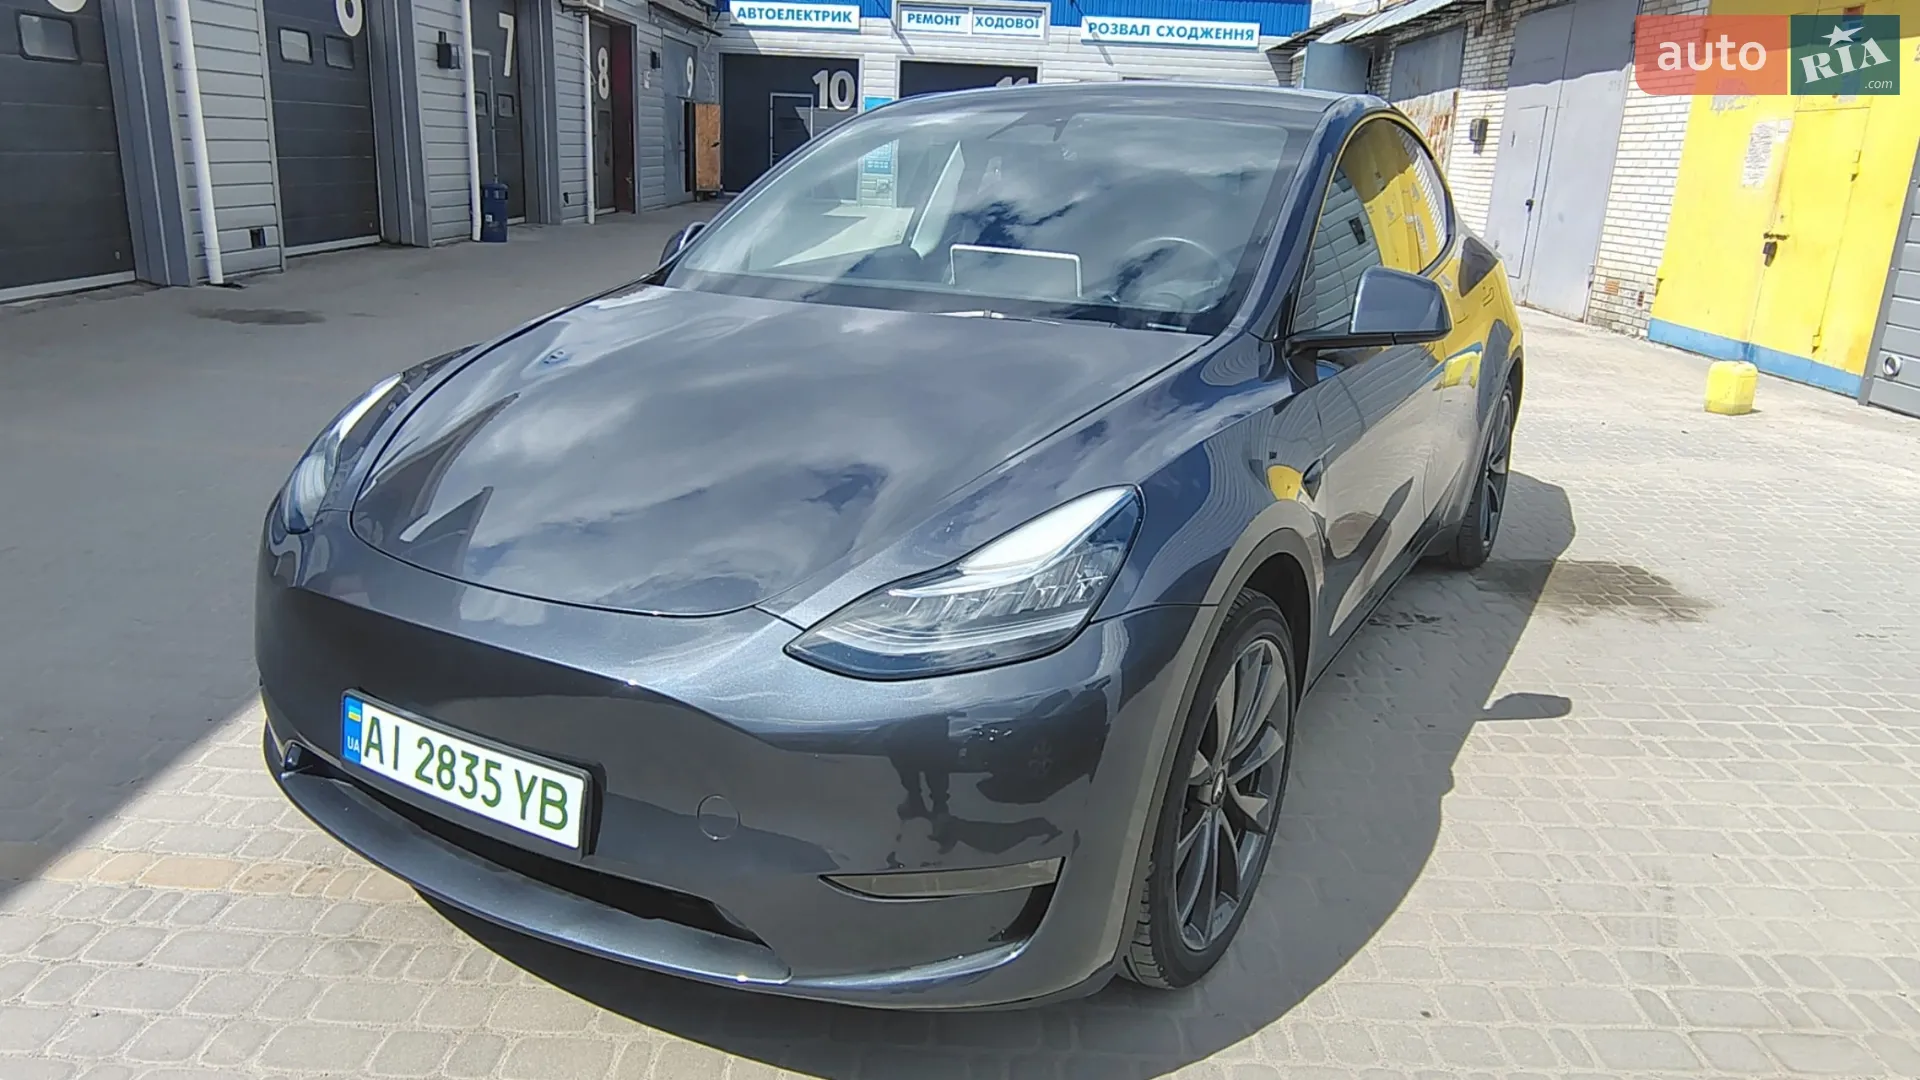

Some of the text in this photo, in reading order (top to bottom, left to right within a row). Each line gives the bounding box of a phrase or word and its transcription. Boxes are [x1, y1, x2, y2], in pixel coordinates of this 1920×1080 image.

[737, 7, 852, 23] АВТОЕЛЕКТРИК
[907, 13, 1039, 30] РЕМОНТ ХОДОВОЇ
[1088, 22, 1254, 40] РОЗВАЛ СХОДЖЕННЯ
[499, 12, 514, 77] 7
[598, 47, 609, 100] 8
[686, 56, 694, 98] 9
[812, 70, 855, 111] 10
[347, 735, 360, 753] UA
[364, 716, 569, 831] AI 2835 YB
